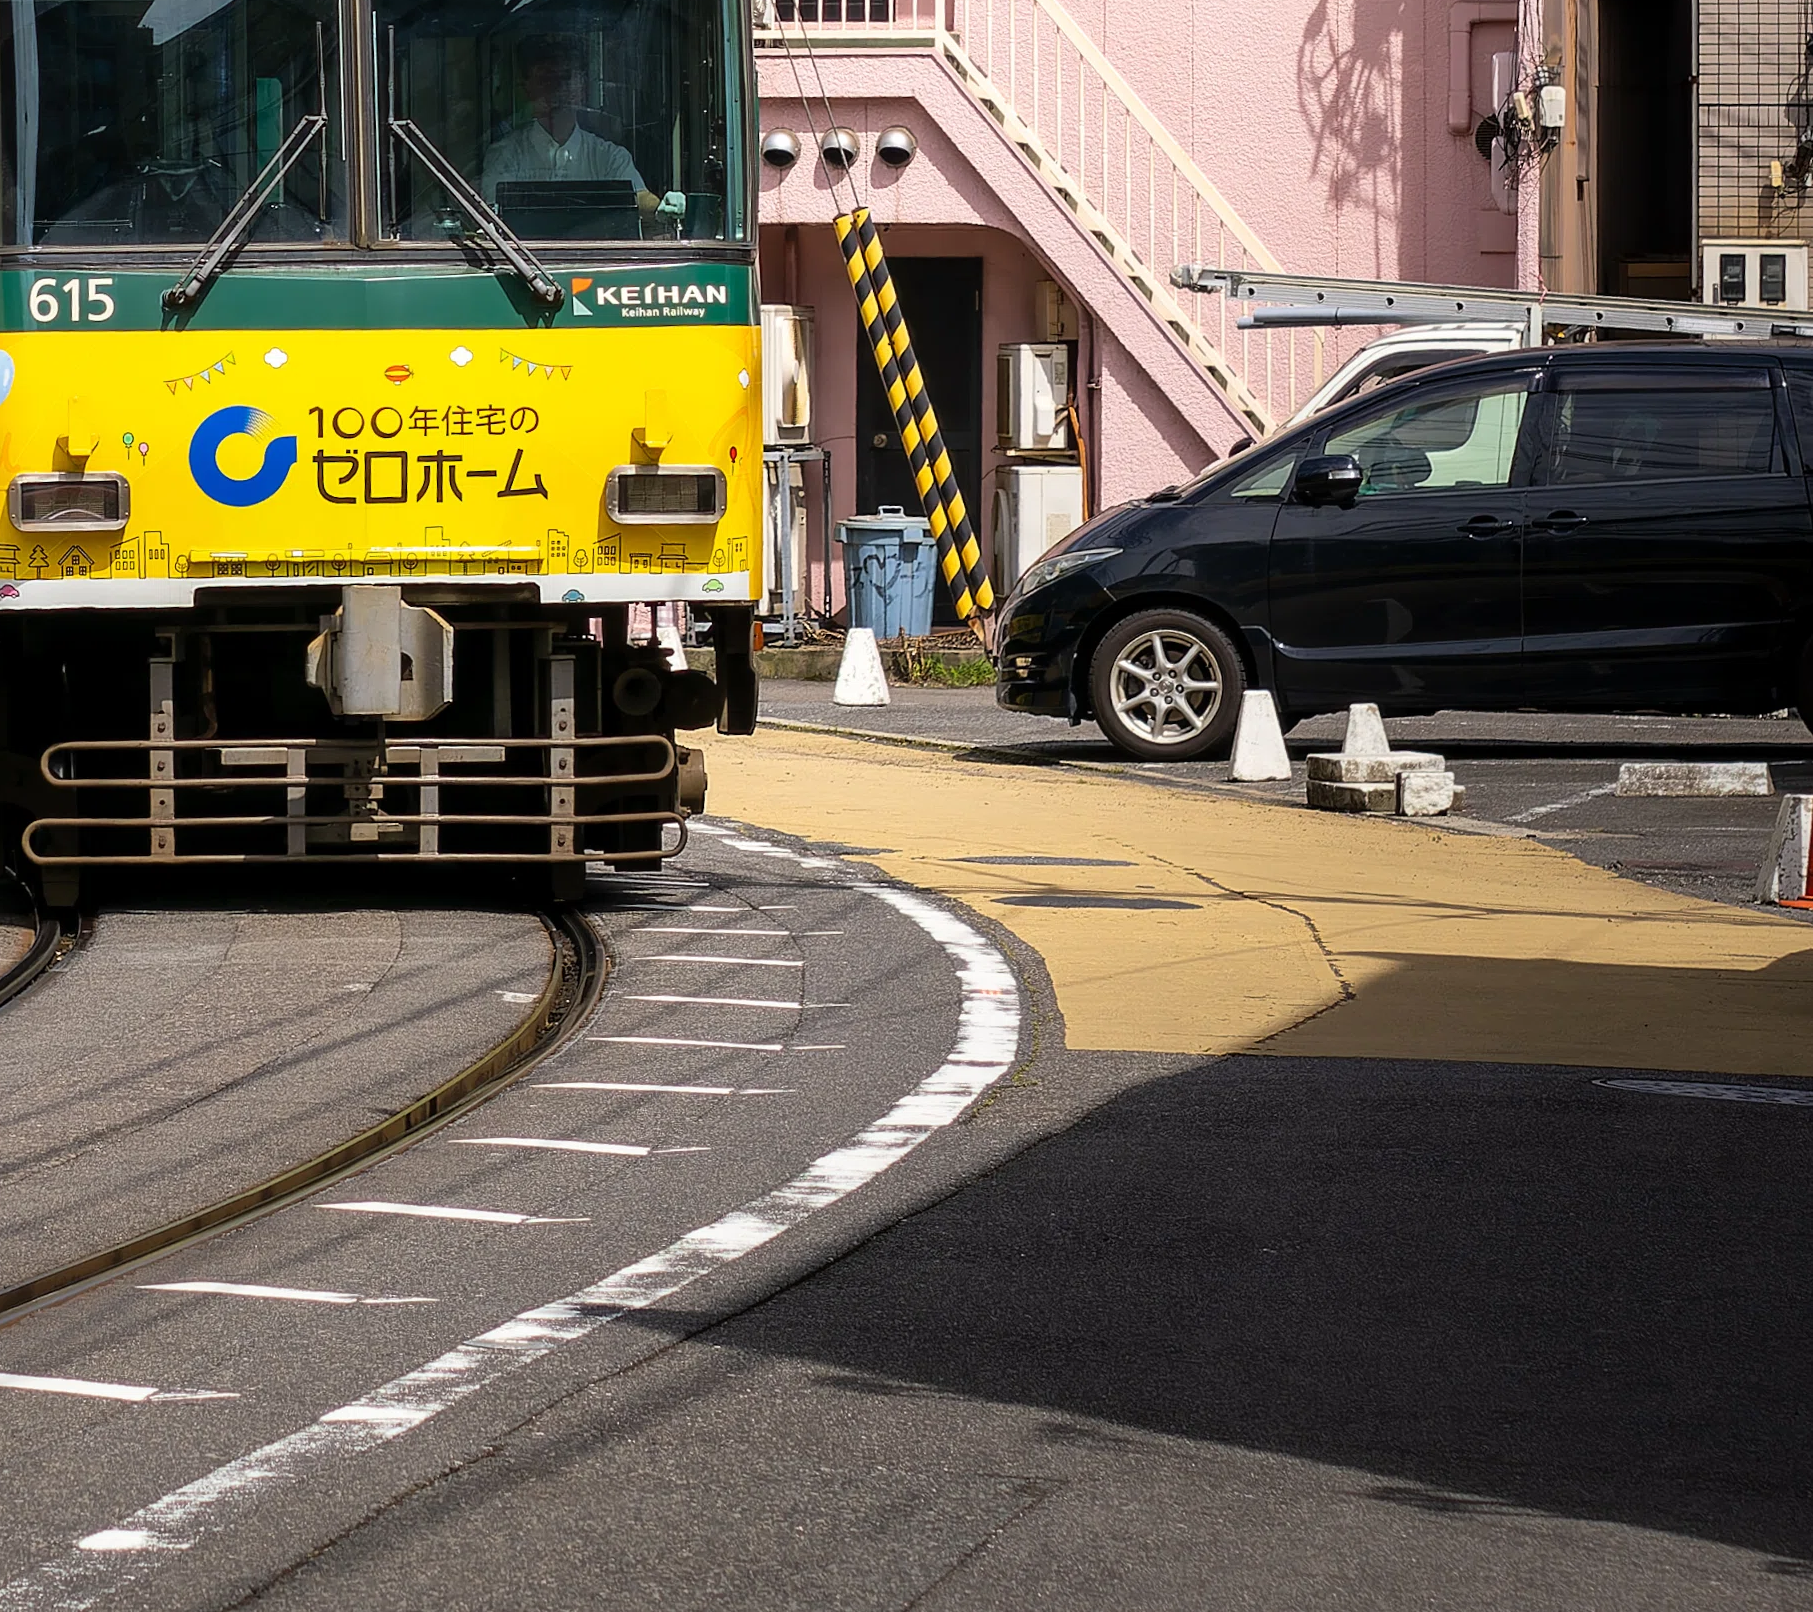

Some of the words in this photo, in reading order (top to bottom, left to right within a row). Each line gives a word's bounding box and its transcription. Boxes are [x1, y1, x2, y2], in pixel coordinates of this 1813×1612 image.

[29, 278, 115, 323] 615
[596, 283, 727, 305] KEIHAN
[621, 306, 660, 318] Keihan
[663, 306, 705, 318] Railway
[308, 405, 540, 439] 100年住宅の
[312, 449, 549, 504] ゼロホーム
